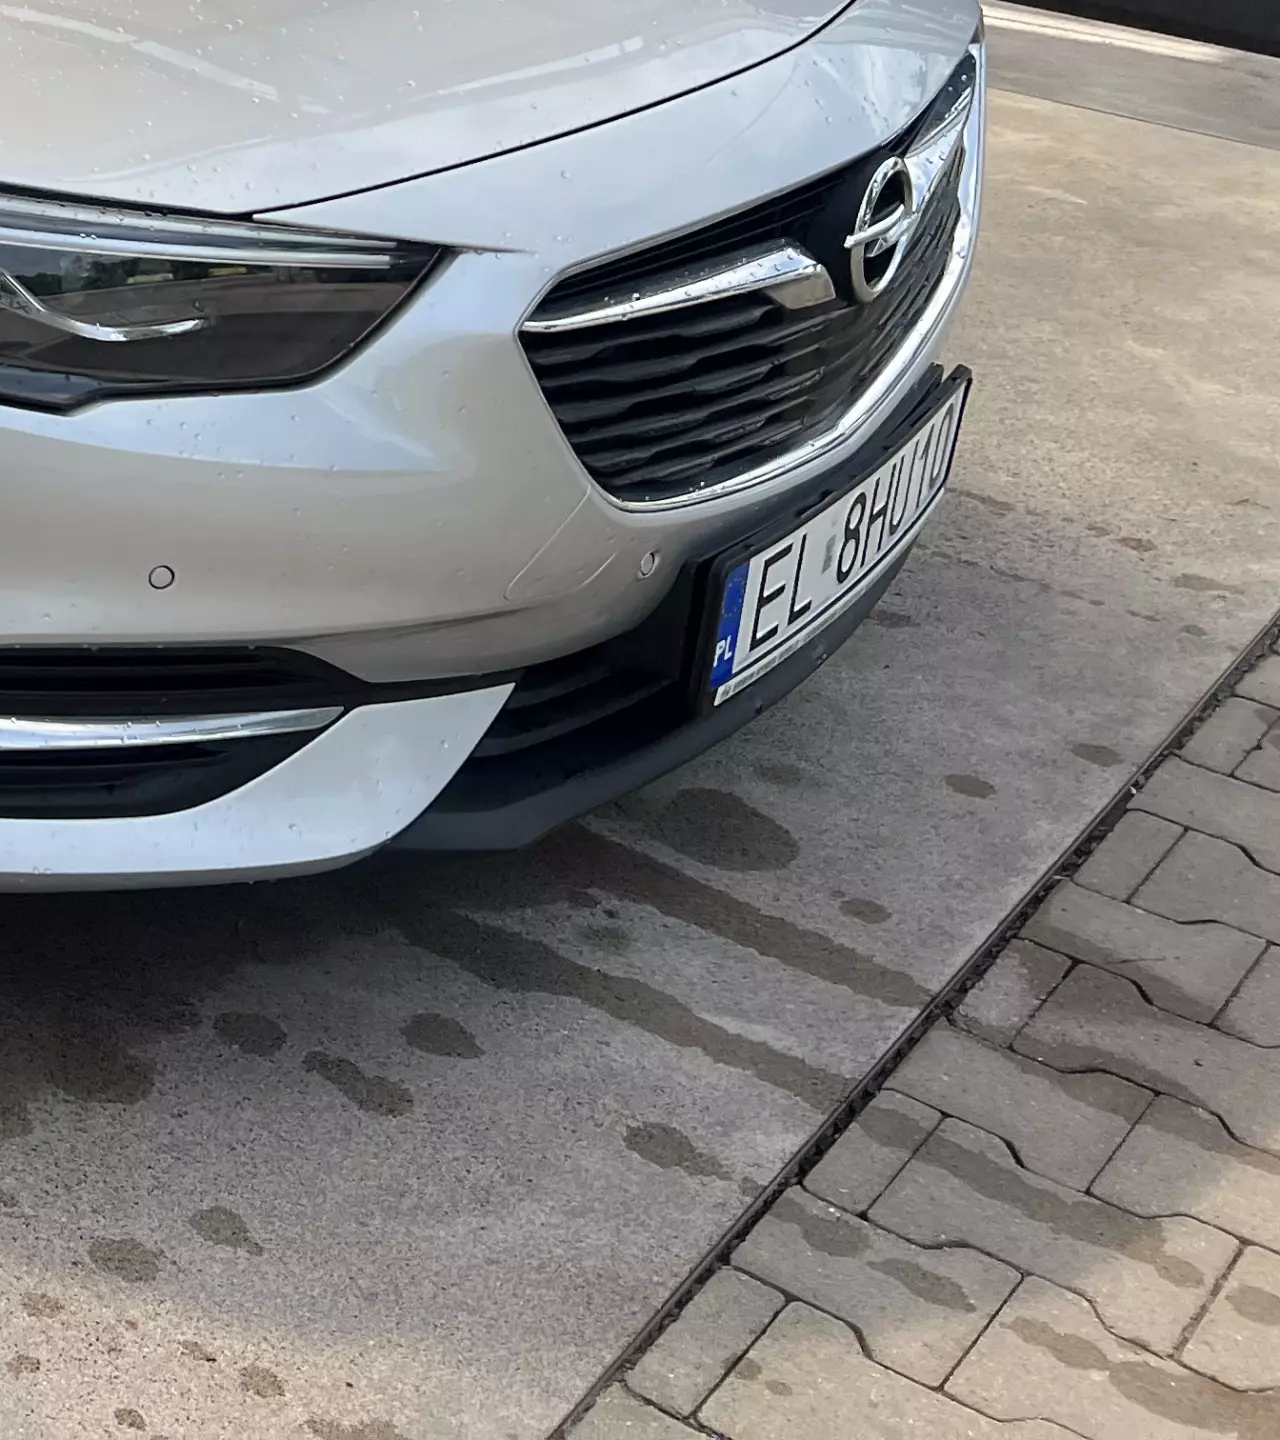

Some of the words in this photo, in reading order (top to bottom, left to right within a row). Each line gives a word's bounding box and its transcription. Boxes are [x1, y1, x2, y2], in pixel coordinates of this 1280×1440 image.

[749, 532, 812, 653] EL
[836, 402, 954, 585] 8HU10
[712, 634, 732, 668] PL
